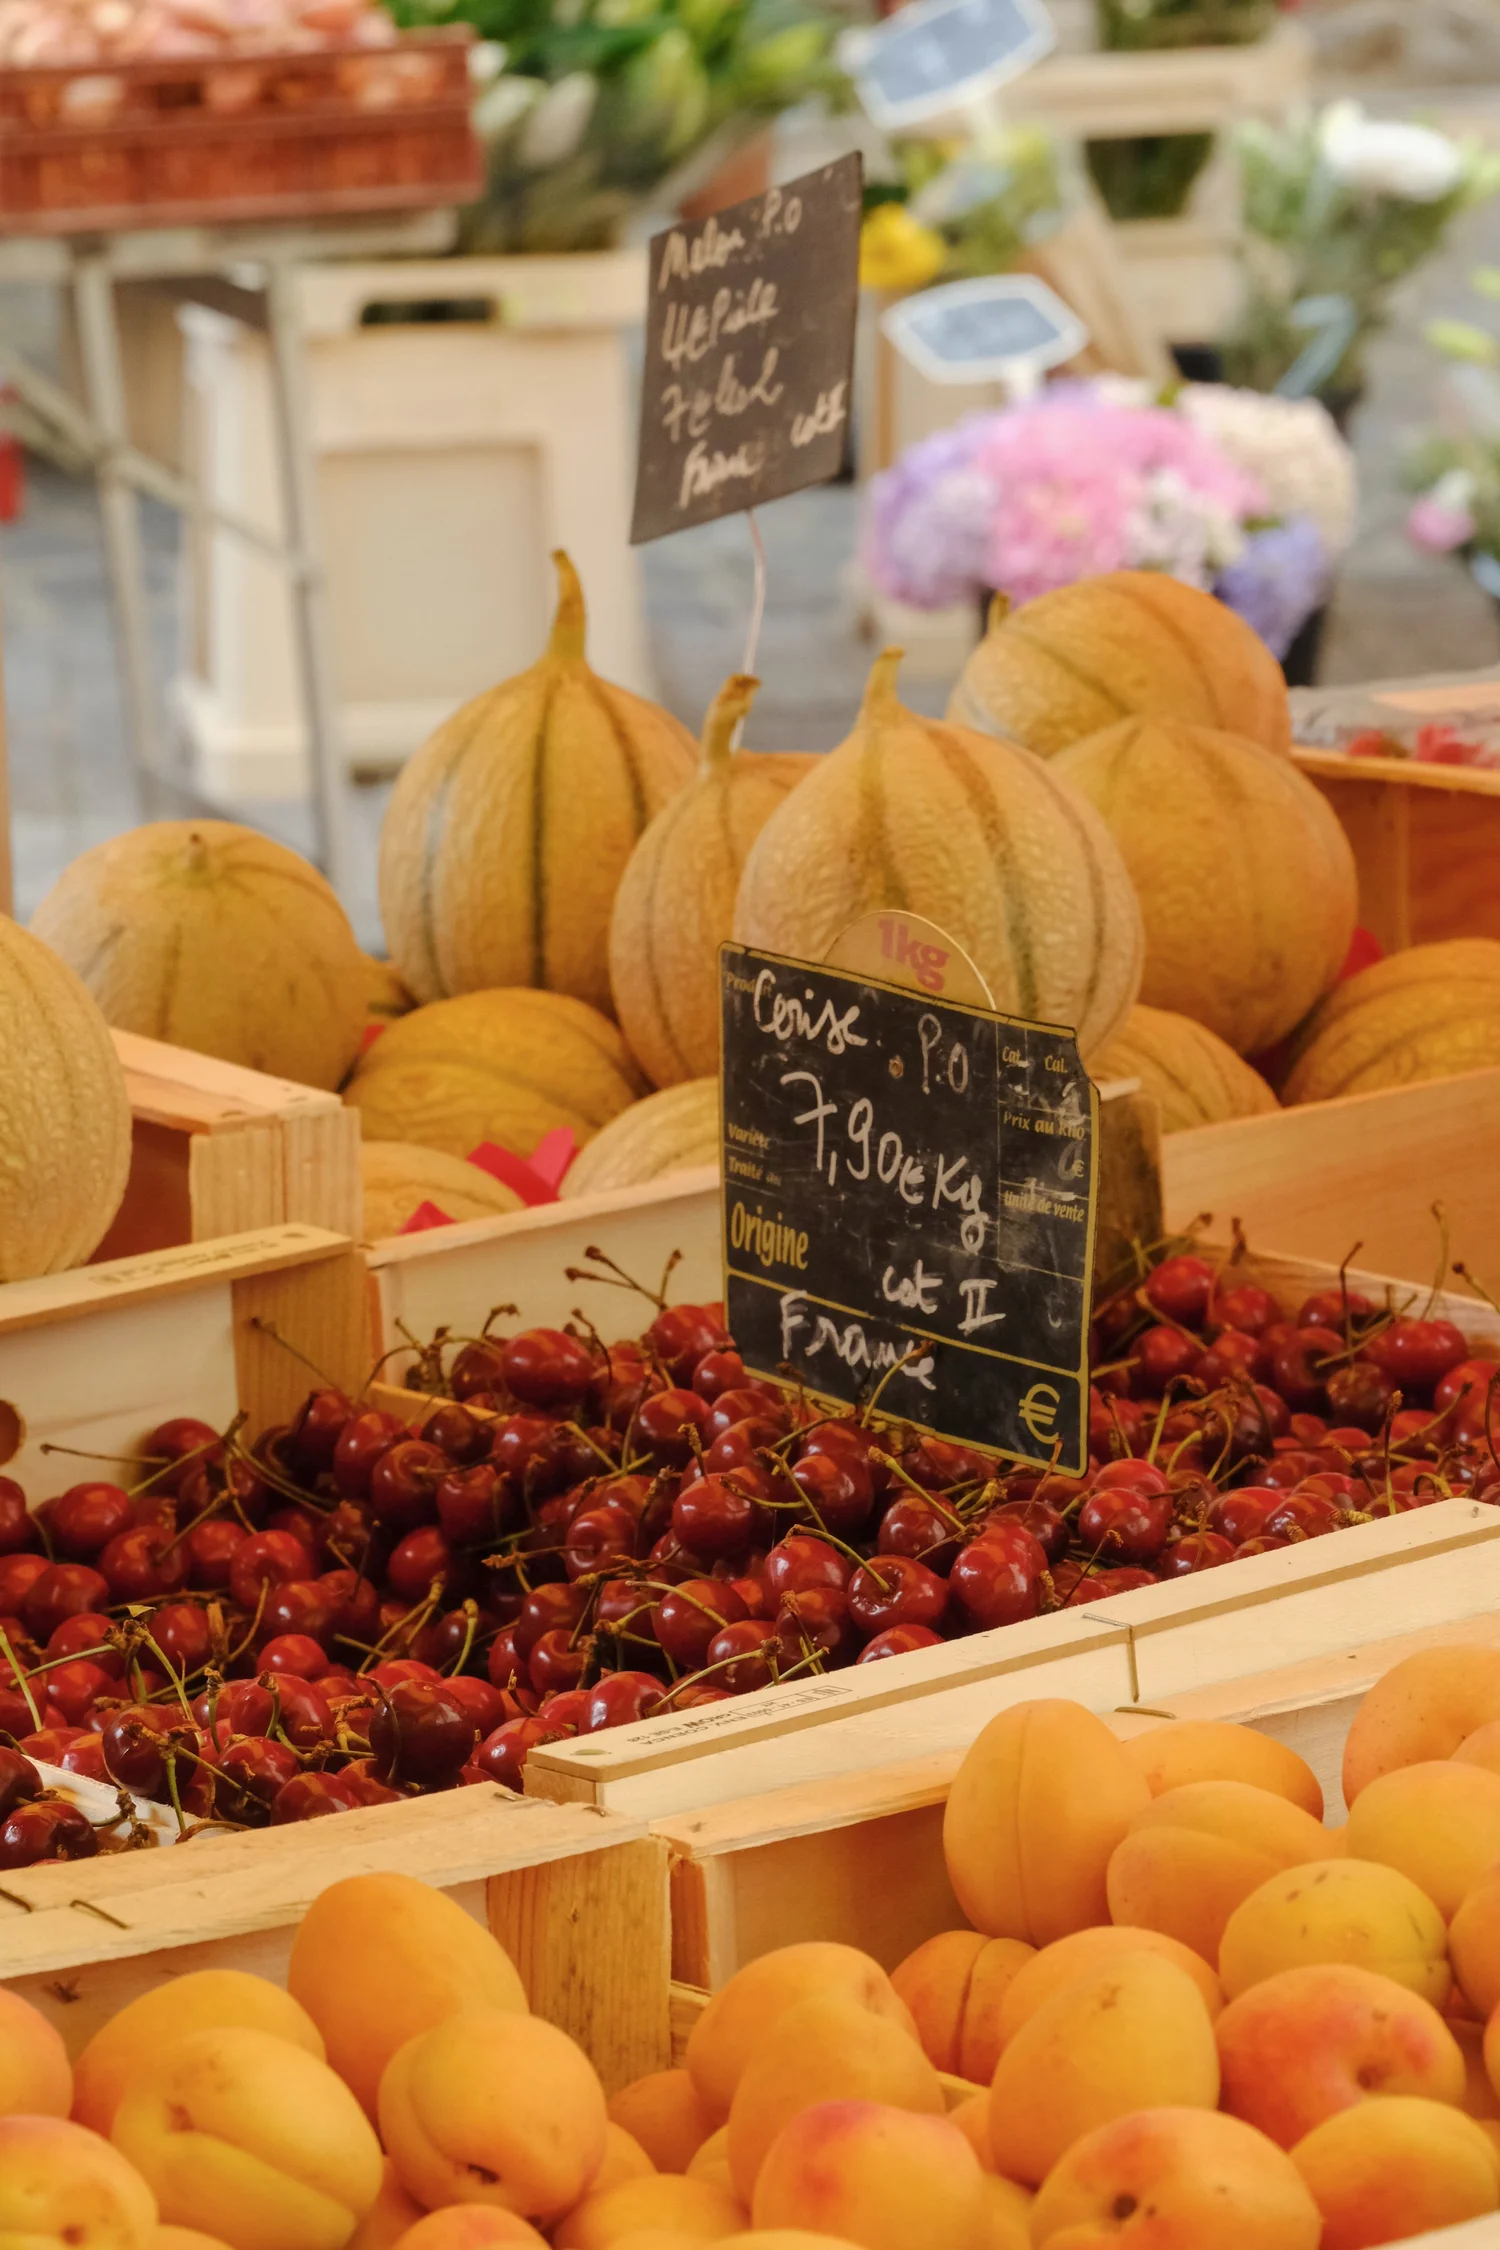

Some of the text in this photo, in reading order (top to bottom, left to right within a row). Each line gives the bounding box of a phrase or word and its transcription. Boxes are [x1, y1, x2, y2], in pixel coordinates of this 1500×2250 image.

[878, 917, 951, 992] 1kg
[724, 970, 772, 998] Prodit
[1003, 1111, 1031, 1131] Prix
[1034, 1119, 1055, 1135] au
[1053, 1203, 1085, 1223] vente
[731, 1201, 809, 1270] Origine
